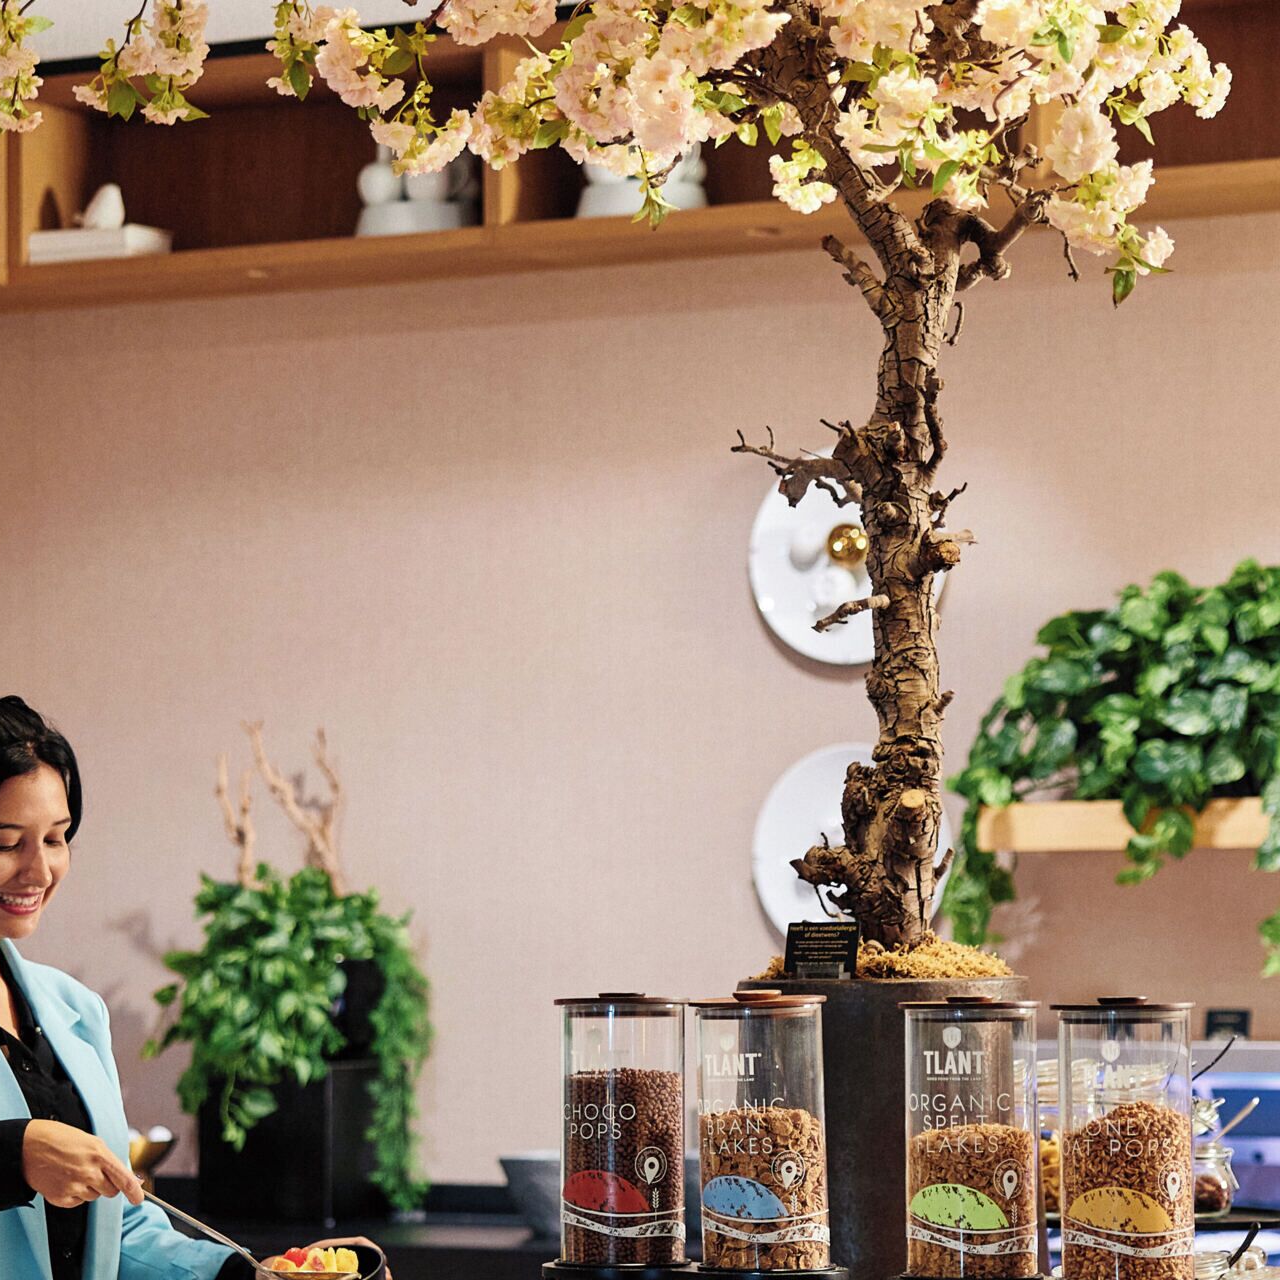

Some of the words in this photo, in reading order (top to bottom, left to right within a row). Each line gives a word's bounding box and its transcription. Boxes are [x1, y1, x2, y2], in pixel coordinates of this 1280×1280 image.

[705, 1052, 757, 1076] TLANT
[923, 1050, 985, 1075] TLANT
[563, 1103, 636, 1120] CHOCO
[697, 1097, 785, 1116] ORGANIC
[908, 1093, 1011, 1112] ORGANIC
[570, 1122, 622, 1140] POPS
[707, 1118, 761, 1135] BRAN
[922, 1114, 989, 1133] SPELT
[702, 1137, 773, 1155] FLAKES
[917, 1135, 1000, 1153] FLAKES
[1062, 1138, 1095, 1157] OAT
[1109, 1137, 1172, 1158] POPS
